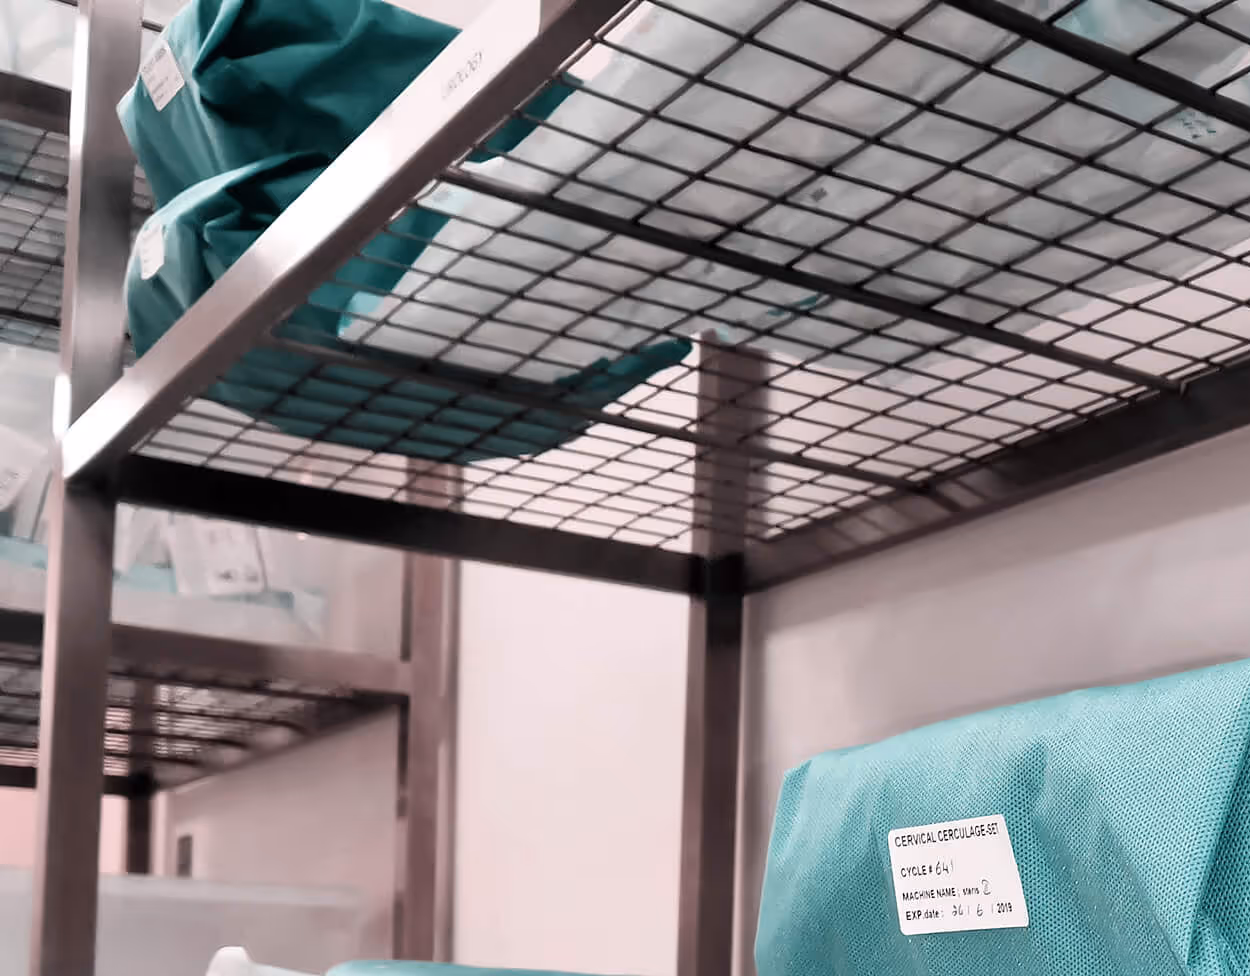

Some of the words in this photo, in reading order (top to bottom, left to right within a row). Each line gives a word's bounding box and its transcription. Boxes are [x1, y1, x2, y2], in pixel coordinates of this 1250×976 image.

[895, 834, 936, 848] CERVICAL
[938, 823, 999, 842] CERCULAGE-SET
[901, 865, 927, 877] CYCLE
[902, 889, 936, 901] MACHINE
[937, 887, 956, 898] NAME
[997, 902, 1013, 913] 2019
